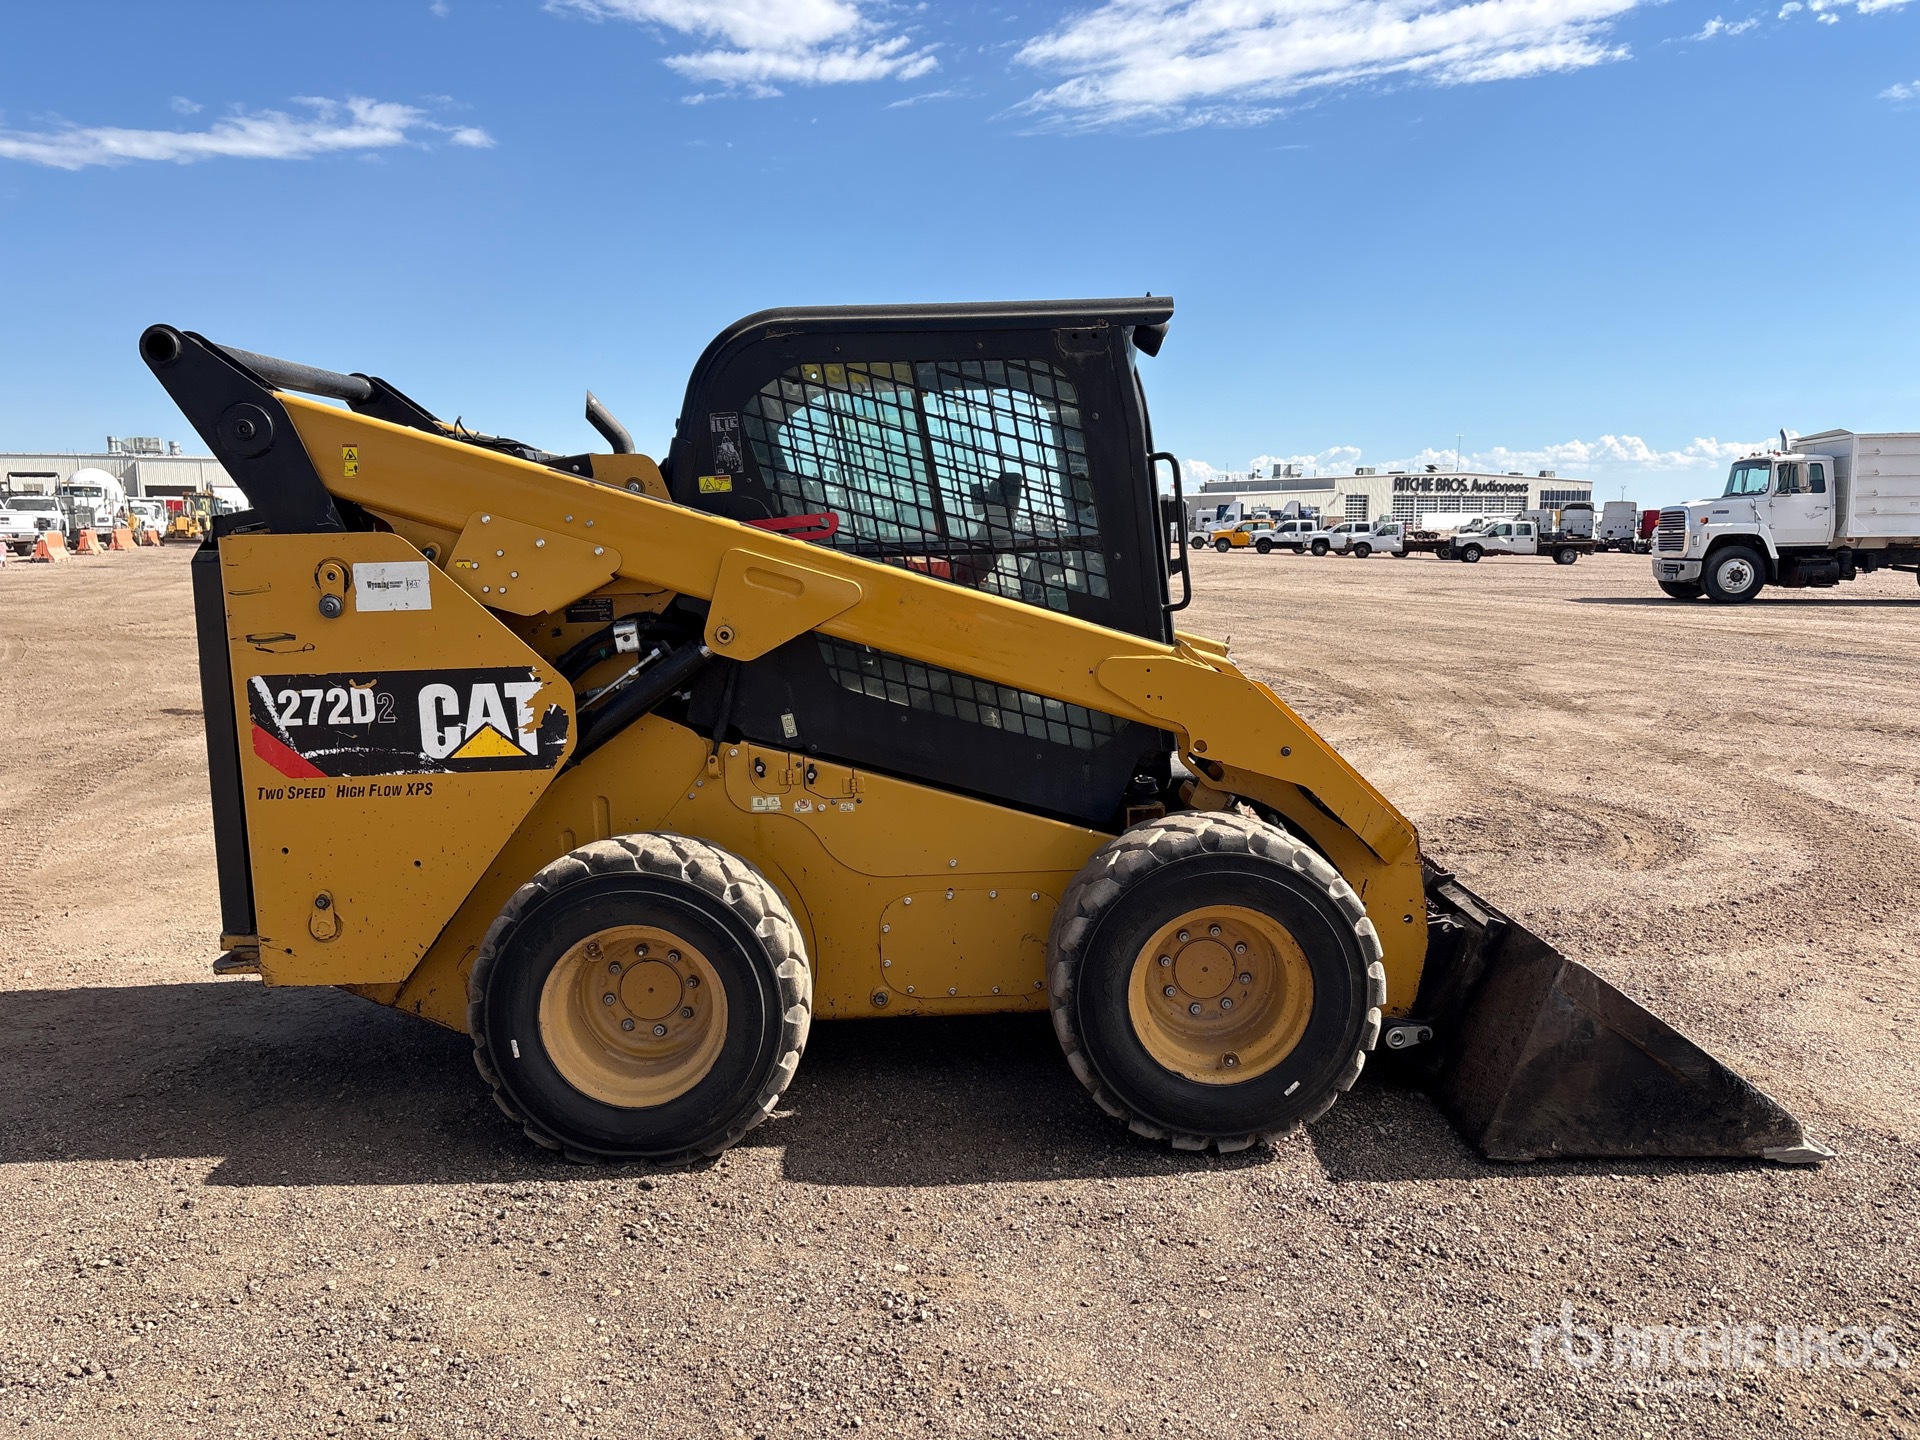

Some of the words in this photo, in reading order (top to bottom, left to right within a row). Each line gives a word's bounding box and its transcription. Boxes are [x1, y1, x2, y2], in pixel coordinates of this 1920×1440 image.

[1394, 477, 1434, 491] RITCHIE
[1436, 478, 1469, 492] BROS.
[1471, 479, 1529, 492] Auctioneers
[366, 580, 389, 590] Wyoming
[418, 681, 543, 759] CAT
[257, 787, 283, 800] TWO
[287, 786, 326, 800] SPEED
[336, 784, 365, 798] HIGH
[369, 783, 402, 797] FLOW
[406, 782, 433, 796] XPS
